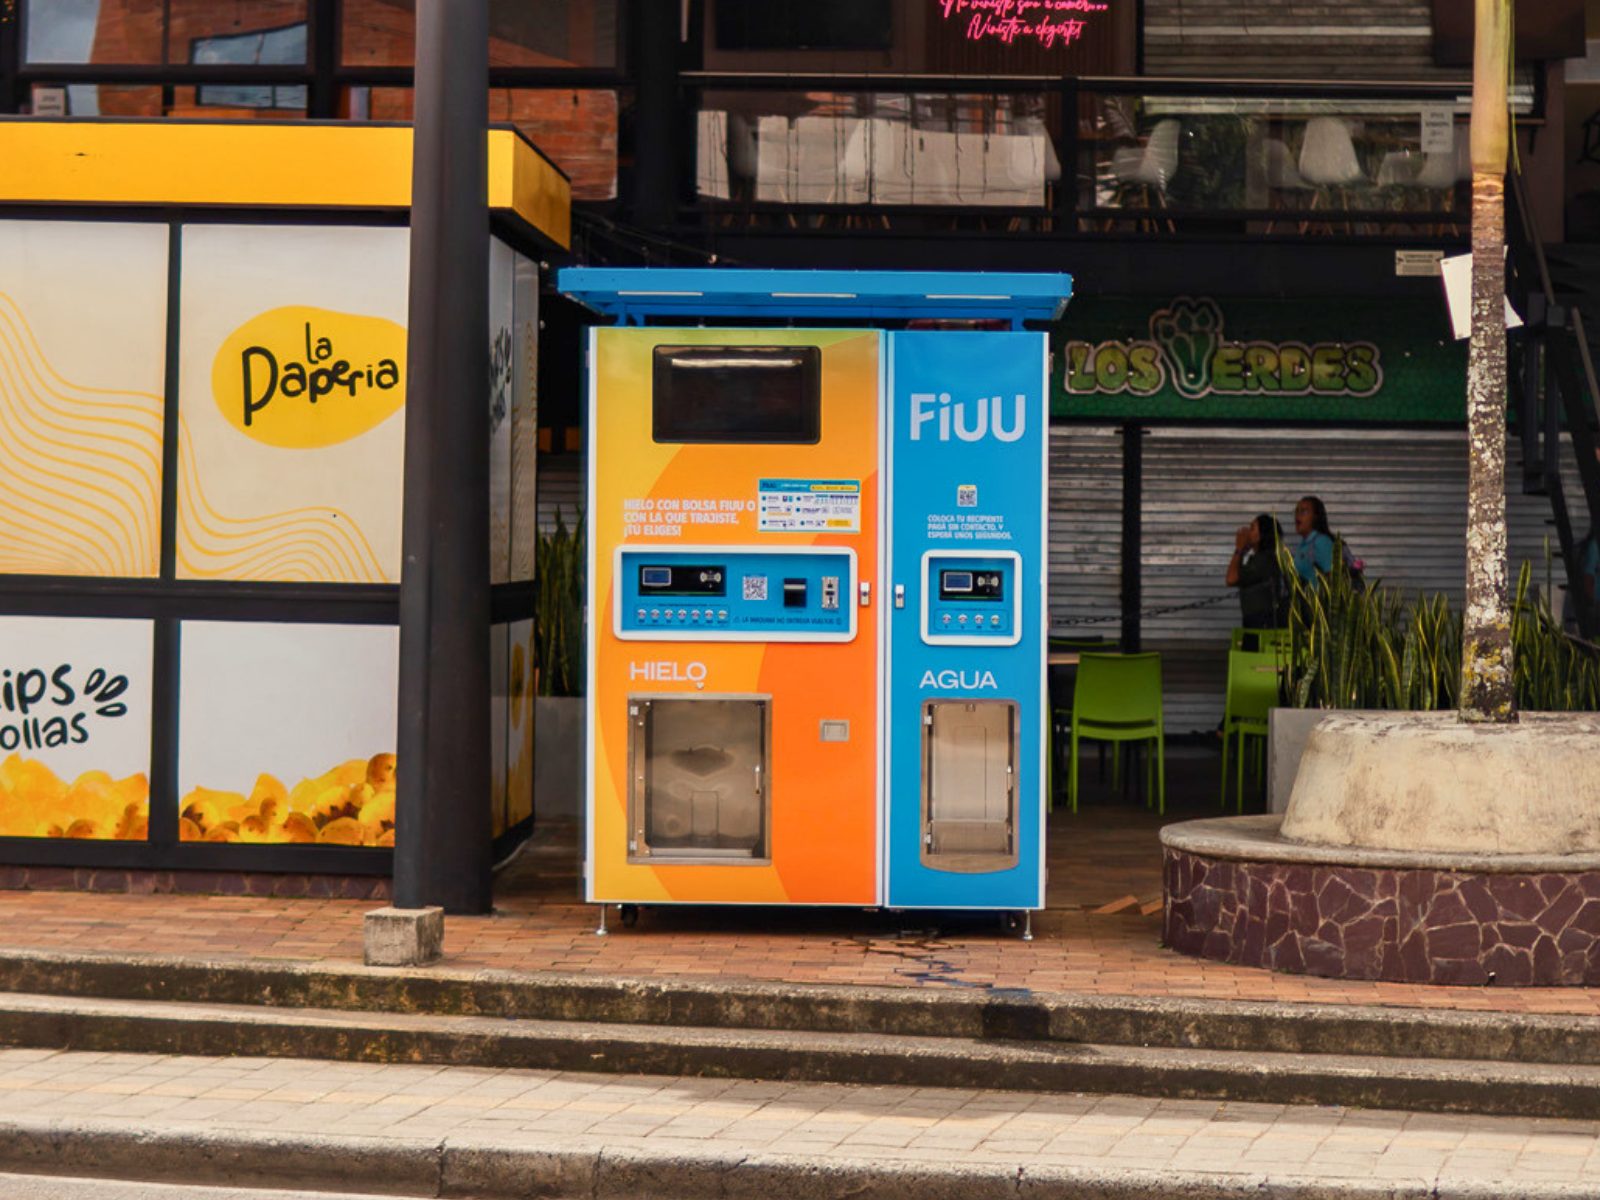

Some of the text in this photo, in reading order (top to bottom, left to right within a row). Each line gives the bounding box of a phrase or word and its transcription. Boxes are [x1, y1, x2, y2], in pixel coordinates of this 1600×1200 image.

[305, 321, 333, 365] la
[1066, 341, 1164, 394] LOS
[241, 345, 400, 427] Paperia
[623, 498, 655, 511] HIELO
[656, 499, 681, 511] CON
[682, 500, 718, 511] BOLSA
[746, 501, 757, 512] O
[623, 511, 647, 524] CON
[649, 512, 664, 524] LA
[665, 512, 688, 525] QUE
[629, 661, 708, 682] HIELO
[919, 669, 998, 690] AGUA
